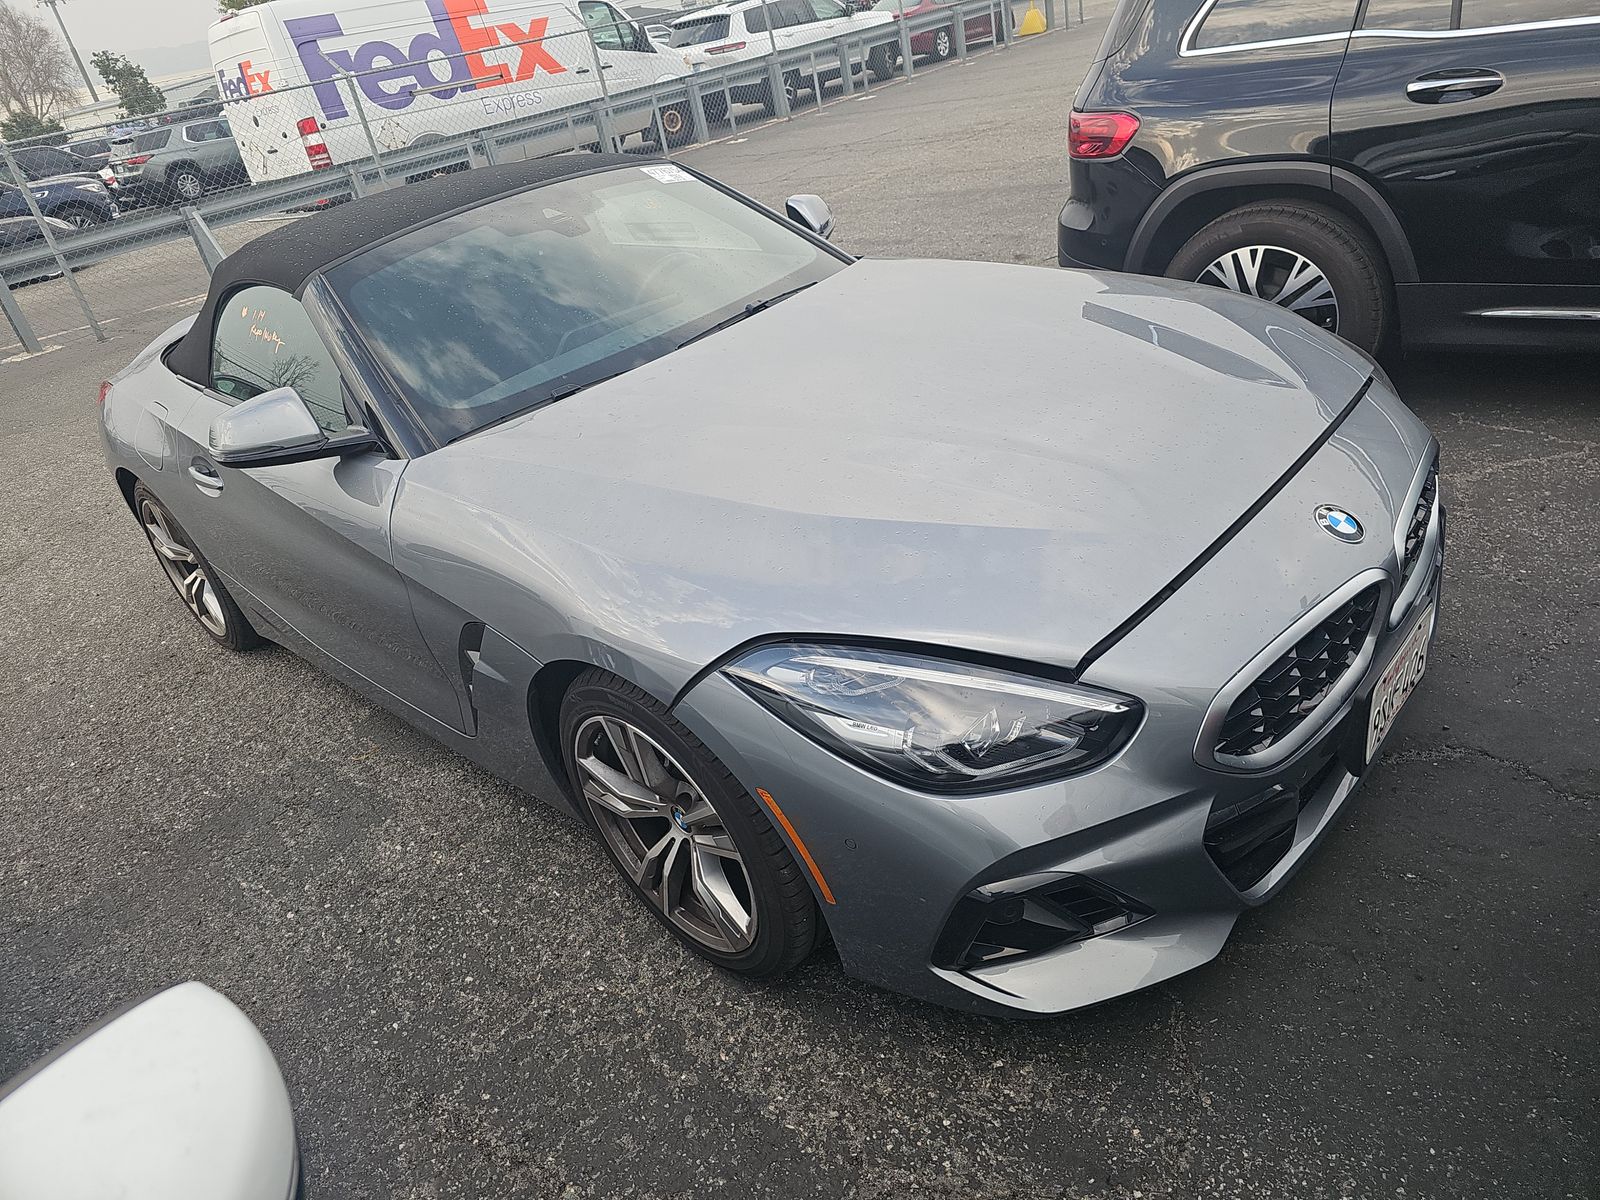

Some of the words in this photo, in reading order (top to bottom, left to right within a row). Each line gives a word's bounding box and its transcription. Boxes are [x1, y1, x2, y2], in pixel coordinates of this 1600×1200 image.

[217, 60, 274, 106] FedEx
[283, 0, 567, 121] FedEx
[480, 91, 542, 115] Express
